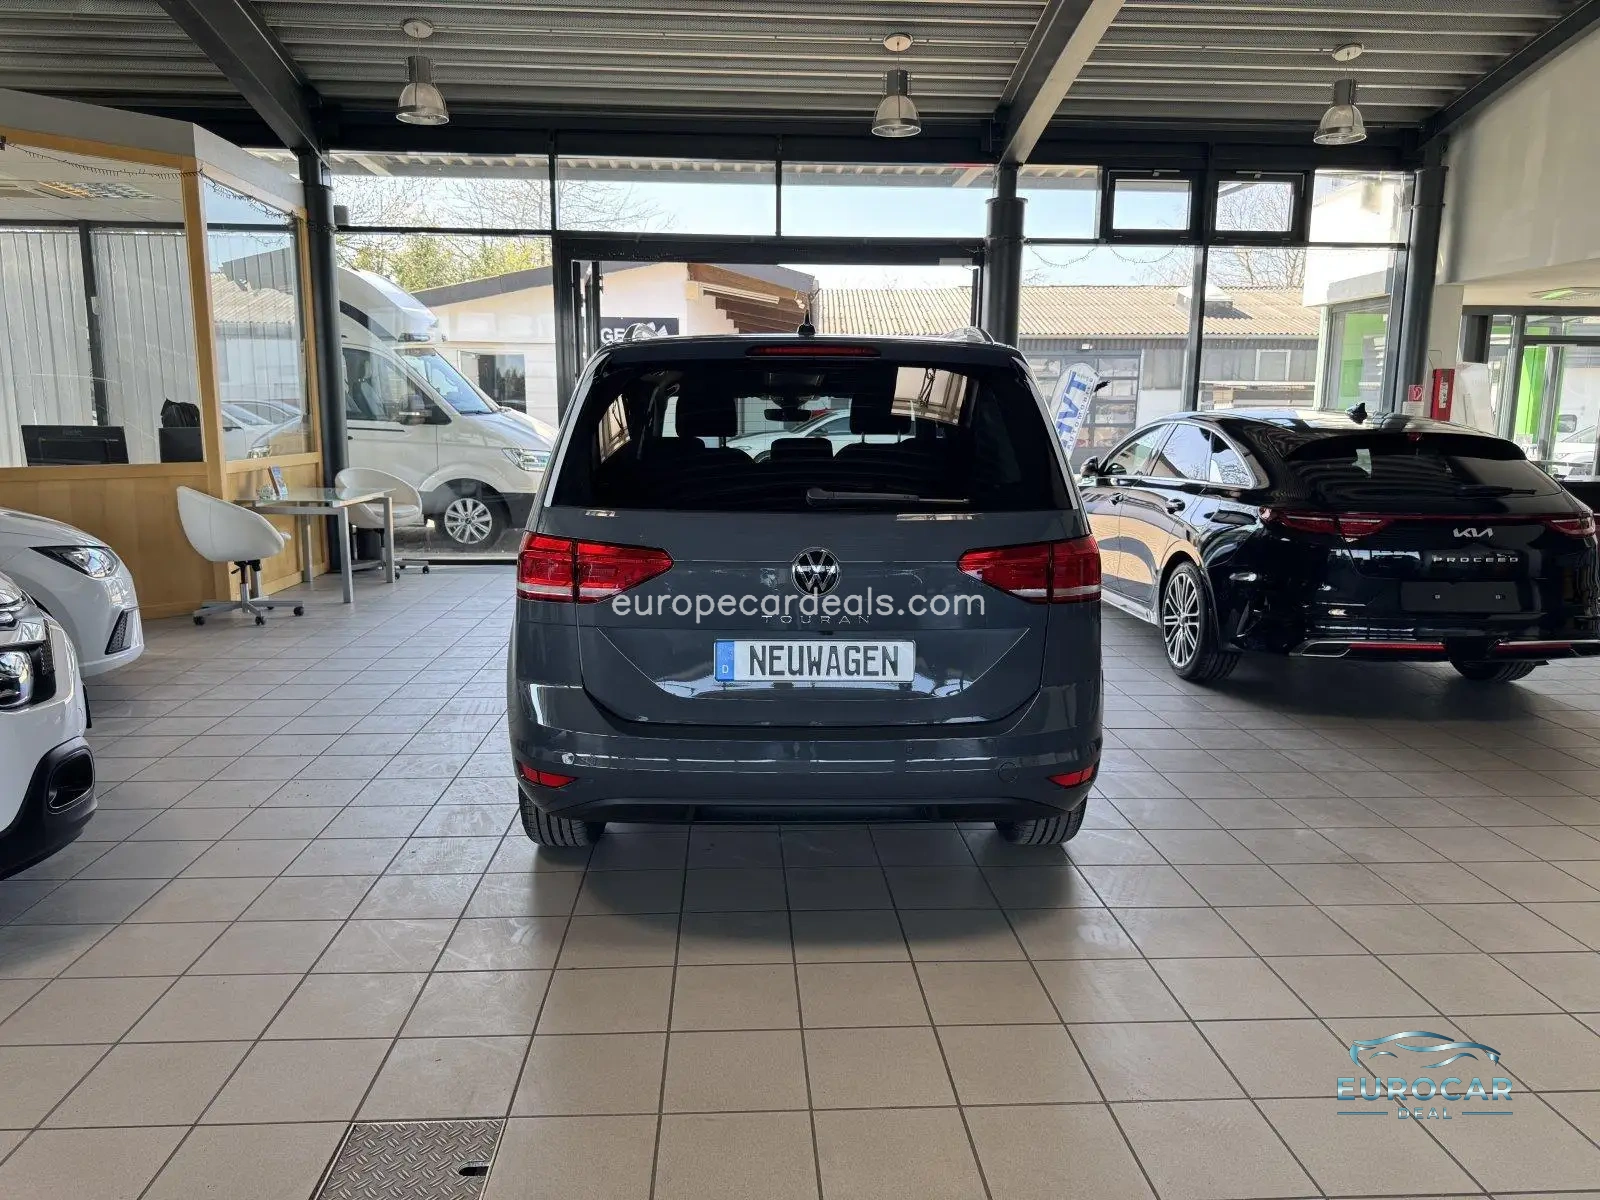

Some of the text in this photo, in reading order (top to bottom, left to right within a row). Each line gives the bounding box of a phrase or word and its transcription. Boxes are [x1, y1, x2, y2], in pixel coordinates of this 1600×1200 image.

[761, 614, 870, 625] TOURAN
[750, 645, 899, 677] NEUWAGEN
[721, 665, 729, 674] D
